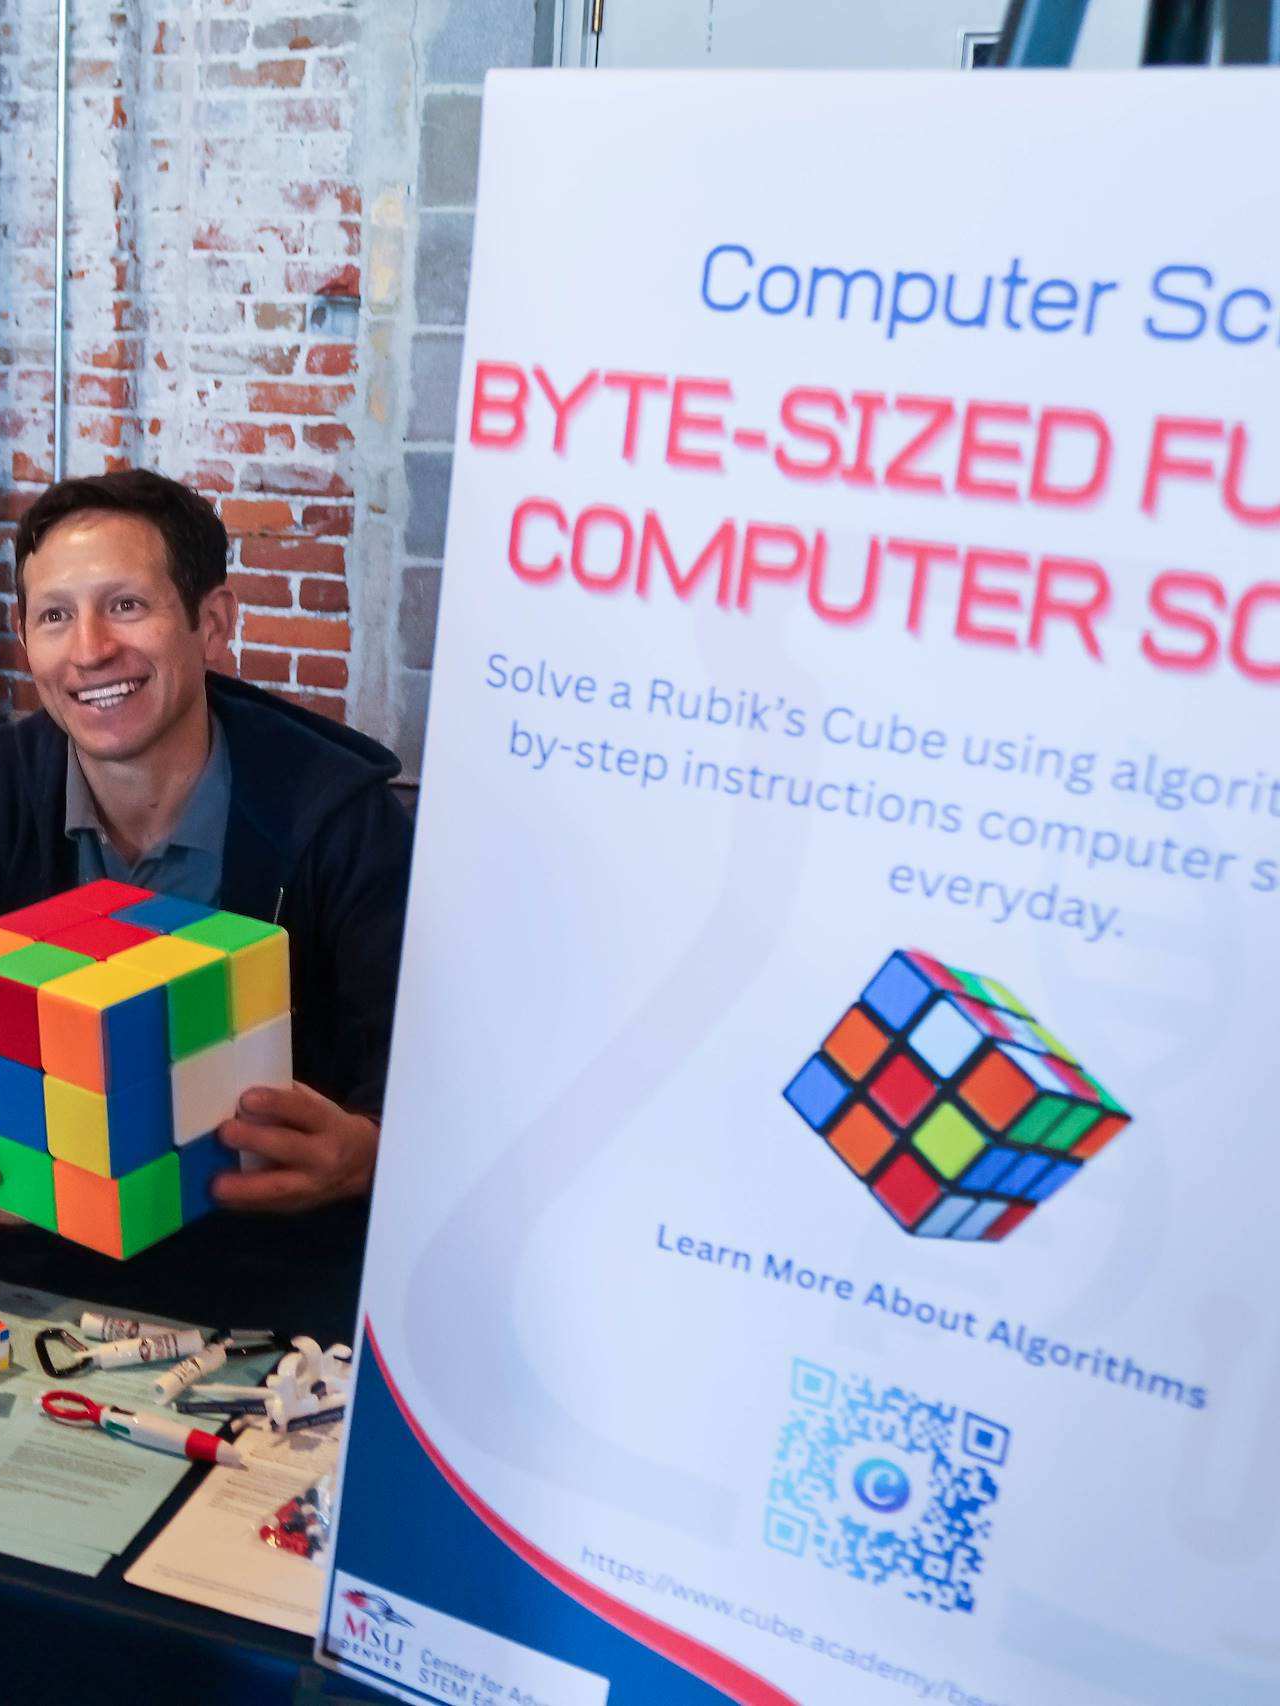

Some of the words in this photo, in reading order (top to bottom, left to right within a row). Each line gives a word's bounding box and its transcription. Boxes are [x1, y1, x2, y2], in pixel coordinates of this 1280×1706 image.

[700, 244, 1119, 340] Computer
[1144, 264, 1280, 346] Sc
[469, 360, 1112, 506] BYTE-SIZED
[507, 496, 1112, 665] COMPUTER
[485, 654, 597, 704] Solve
[610, 680, 632, 711] a
[647, 677, 806, 738] Rubik’s
[822, 706, 947, 760] Cube
[963, 733, 1095, 795] using
[509, 719, 669, 788] by-step
[682, 749, 962, 834] instructions
[979, 810, 1237, 882] computer
[888, 863, 1125, 941] everyday.
[656, 1224, 752, 1274] Learn
[764, 1252, 855, 1301] More
[863, 1282, 977, 1338] About
[987, 1320, 1208, 1412] Algorithms
[339, 1638, 402, 1672] DENVER
[344, 1611, 404, 1656] MSU
[419, 1667, 468, 1700] STEM
[421, 1649, 475, 1683] Center
